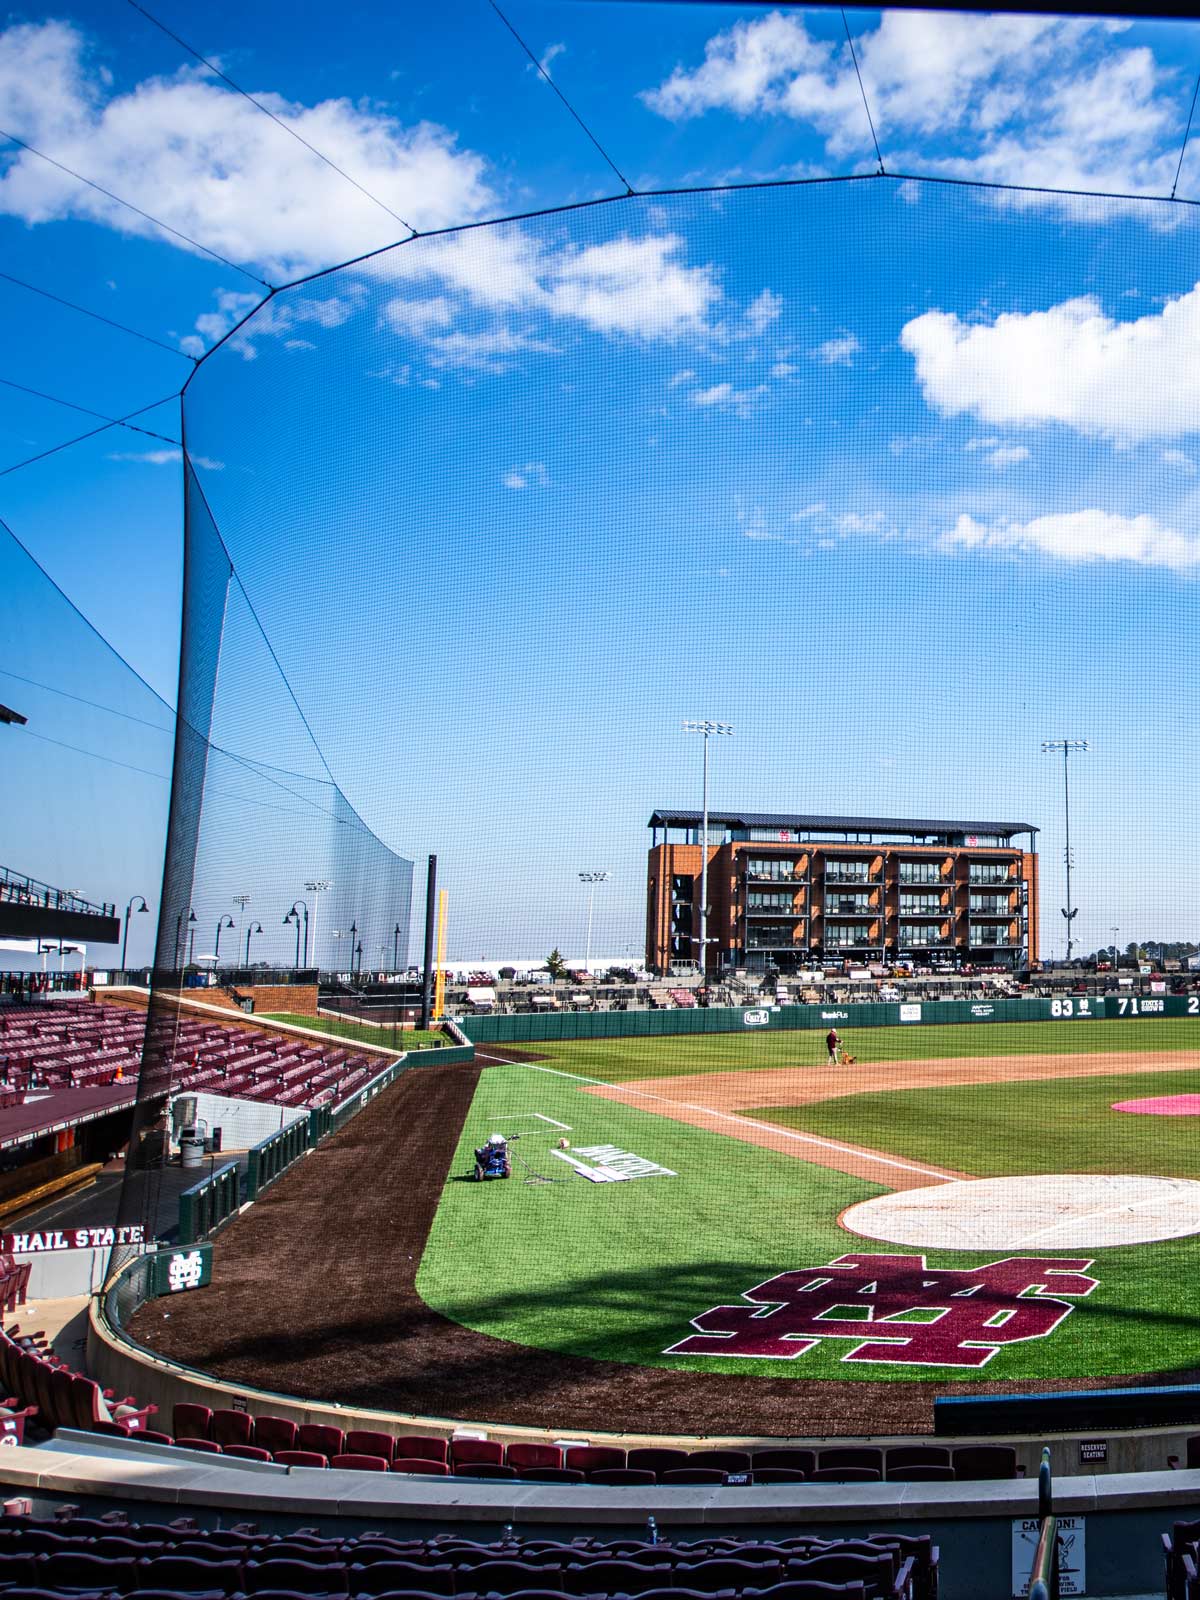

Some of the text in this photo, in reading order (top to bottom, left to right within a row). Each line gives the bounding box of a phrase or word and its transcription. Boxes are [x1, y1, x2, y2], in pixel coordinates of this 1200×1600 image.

[1051, 999, 1073, 1017] 83
[1118, 998, 1139, 1015] 71
[12, 1234, 68, 1252] HAIL
